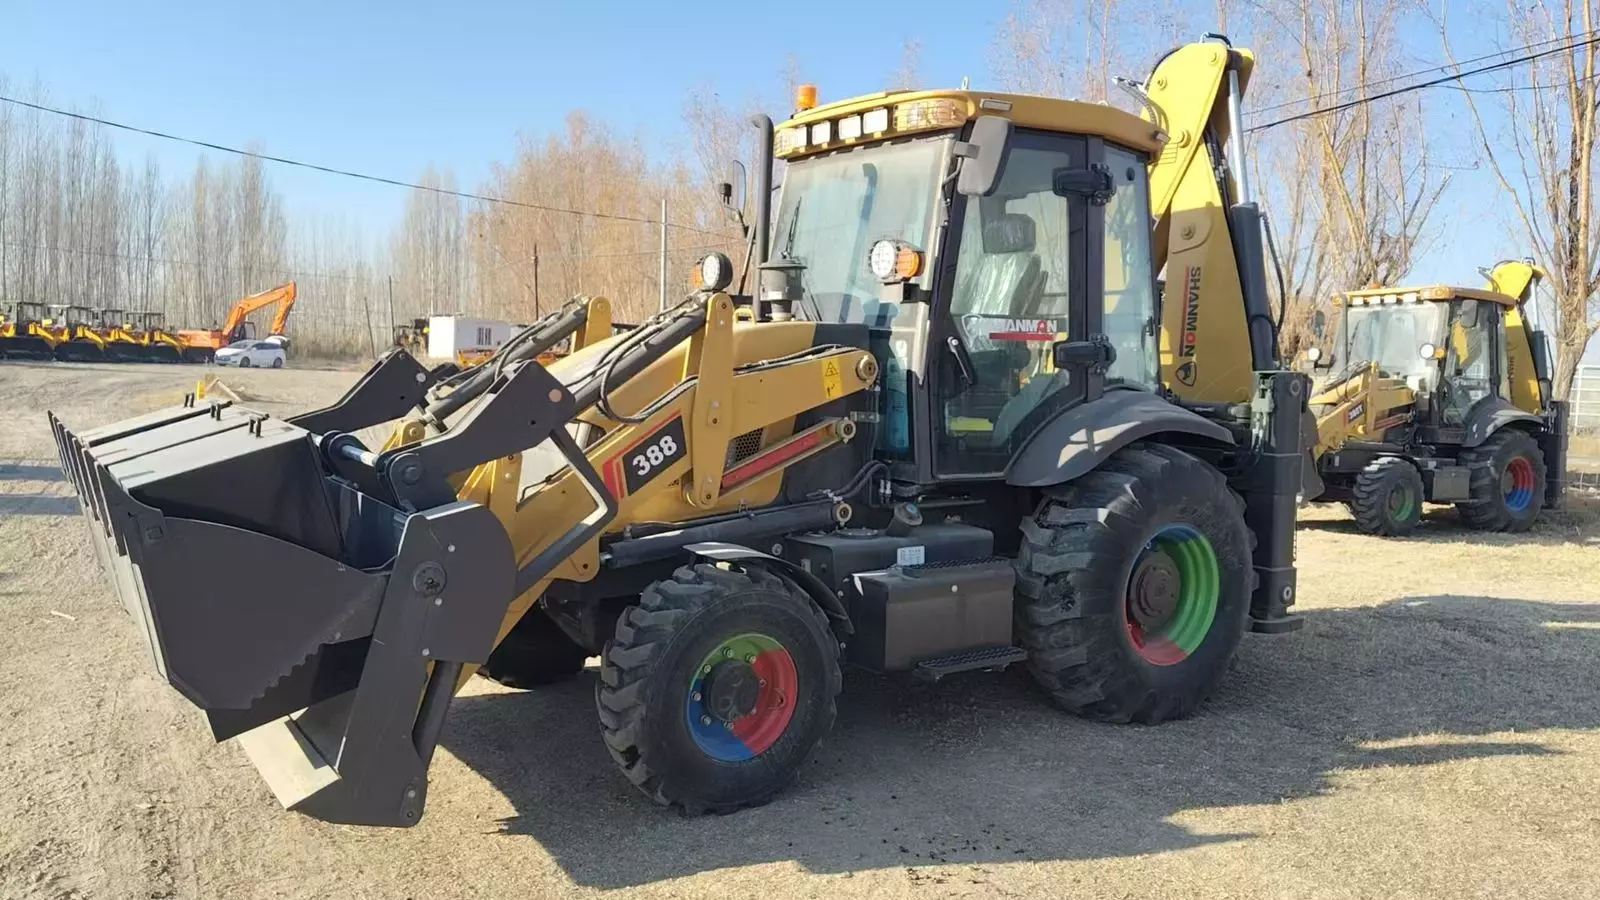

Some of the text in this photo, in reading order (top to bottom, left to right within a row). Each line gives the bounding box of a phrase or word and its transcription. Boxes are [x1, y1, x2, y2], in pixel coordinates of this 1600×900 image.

[988, 319, 1057, 333] ANMON
[1184, 265, 1201, 357] SHANMON
[632, 435, 678, 476] 388
